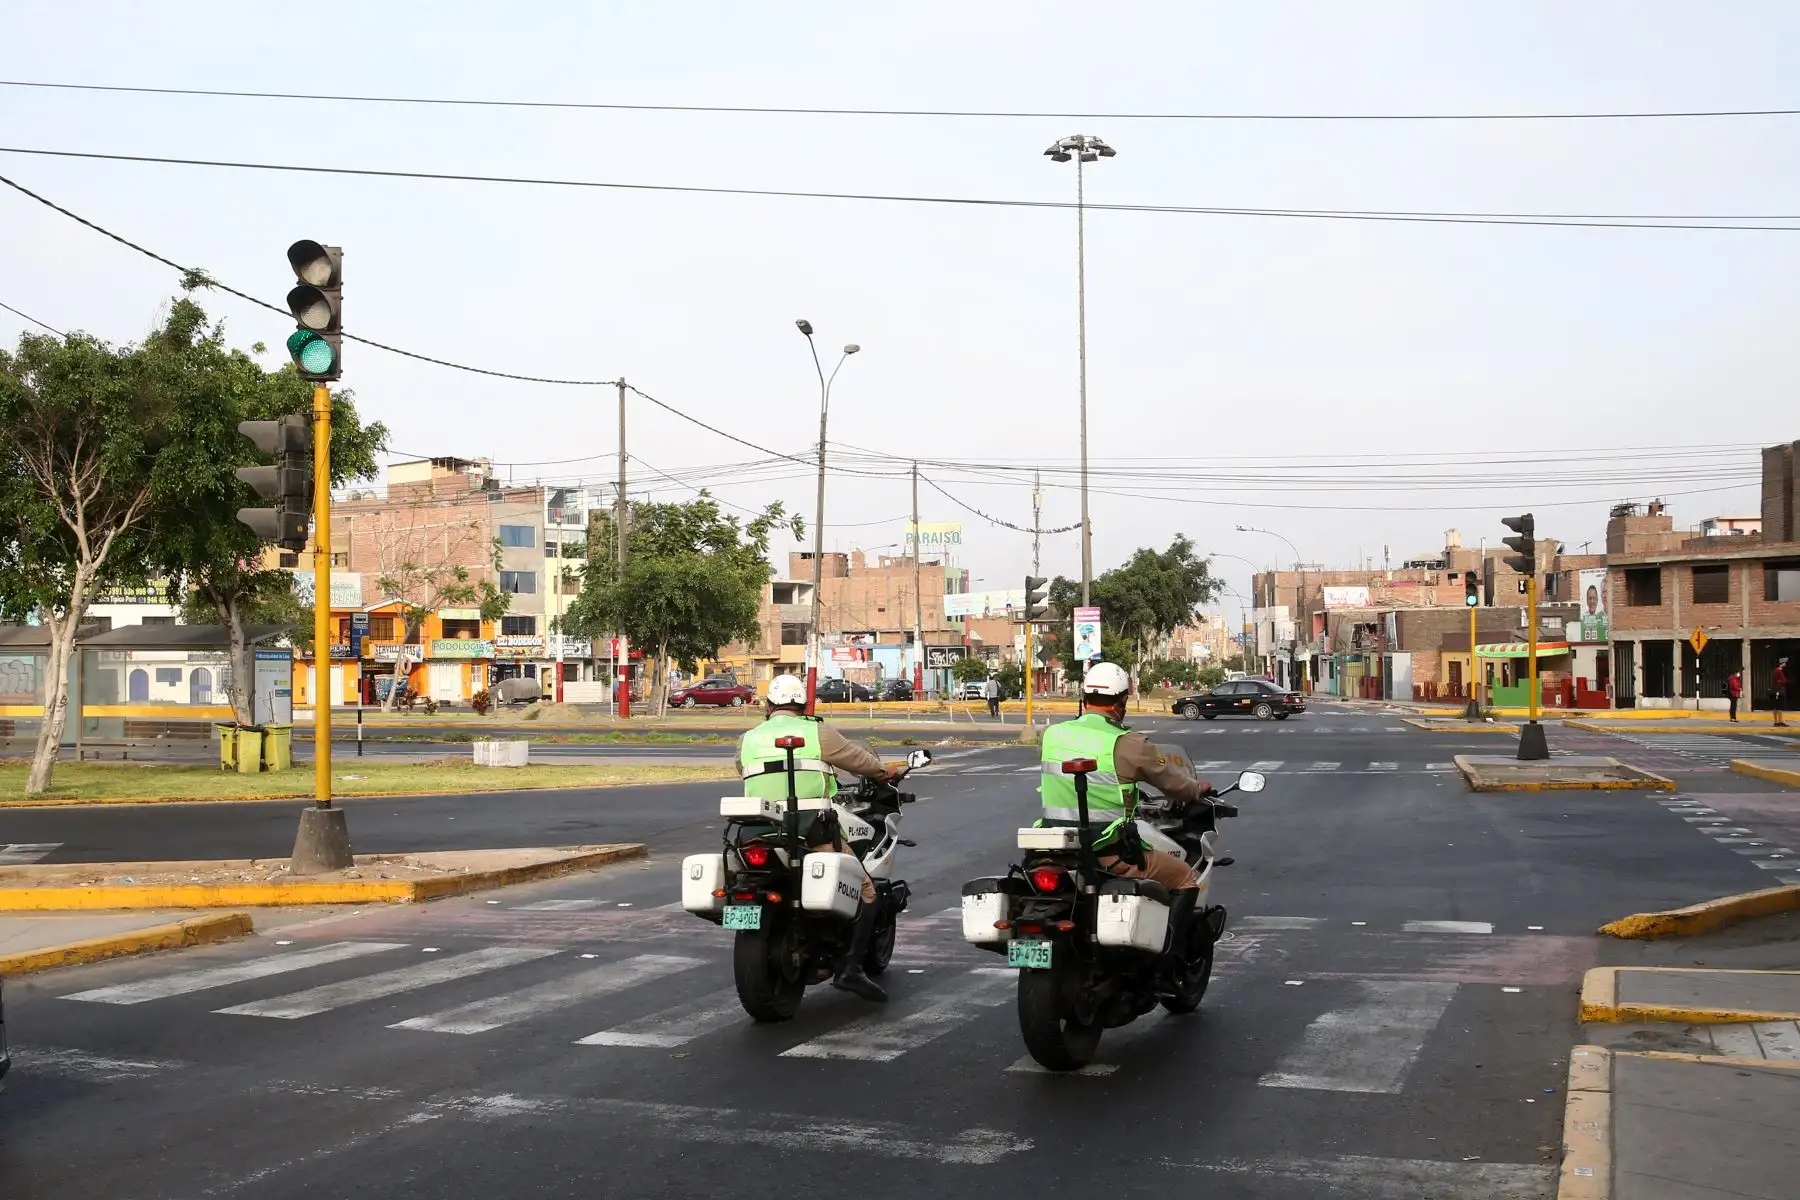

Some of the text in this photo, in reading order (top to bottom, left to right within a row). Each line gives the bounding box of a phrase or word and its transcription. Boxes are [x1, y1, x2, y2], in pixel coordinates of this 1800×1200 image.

[375, 644, 416, 656] SERVILLTAS
[837, 881, 860, 901] POLICIA
[1009, 947, 1049, 963] EP-4735
